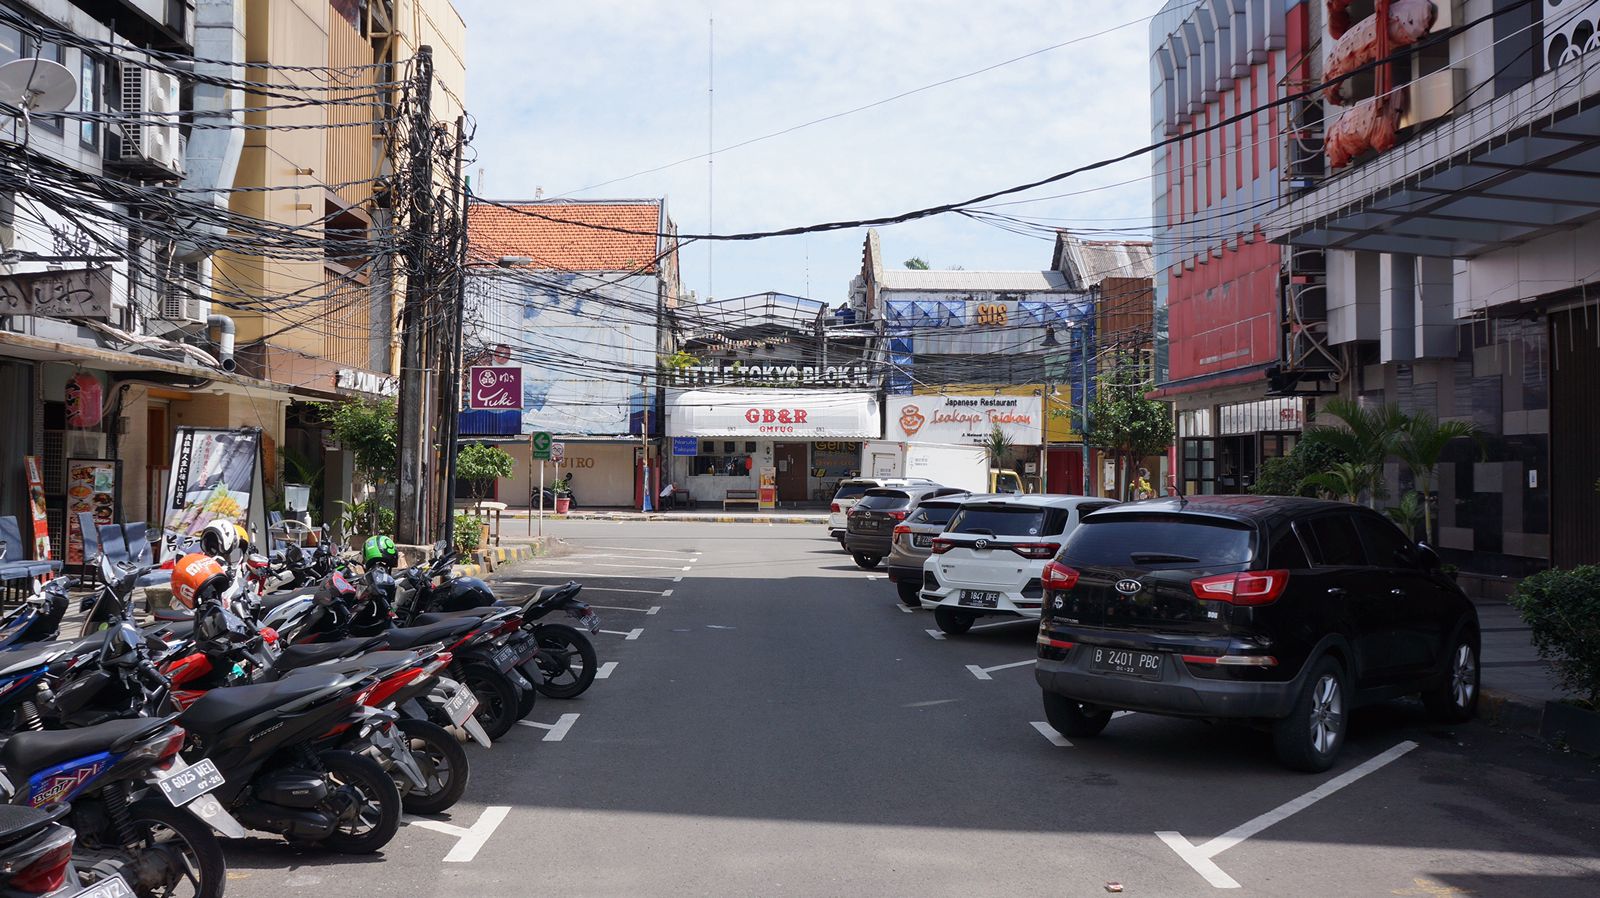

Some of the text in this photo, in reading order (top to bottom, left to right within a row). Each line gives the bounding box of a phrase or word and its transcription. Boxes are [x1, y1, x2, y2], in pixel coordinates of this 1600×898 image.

[977, 302, 1009, 325] SOS
[740, 366, 798, 384] TOKYO
[803, 366, 851, 384] BLOK
[477, 388, 516, 407] Yuki
[945, 397, 1017, 407] Japanese Restaurant
[745, 408, 808, 424] GB&R
[961, 591, 966, 599] B
[1095, 649, 1159, 669] B 2401 PBC
[162, 762, 215, 793] B 6025 WEL
